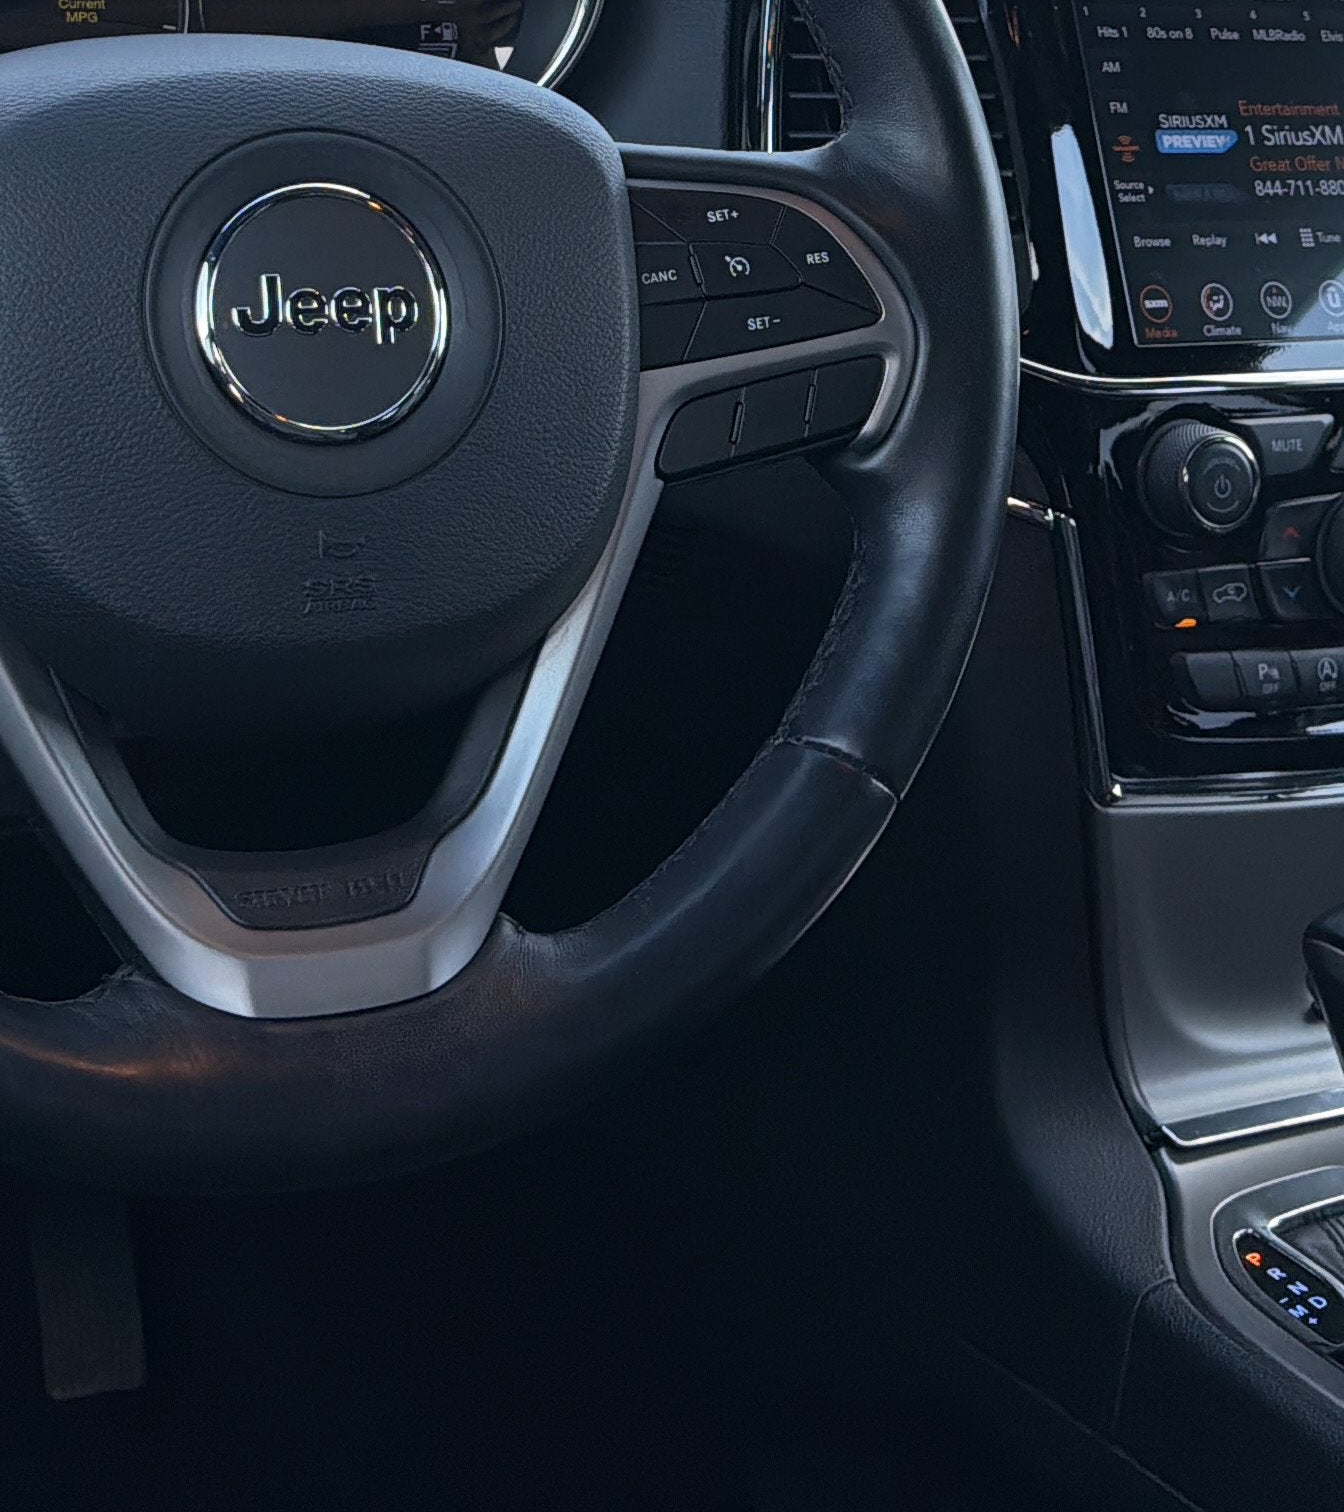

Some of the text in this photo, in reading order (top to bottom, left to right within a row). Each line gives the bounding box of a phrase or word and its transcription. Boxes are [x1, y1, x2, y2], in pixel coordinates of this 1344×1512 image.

[66, 10, 98, 23] MPG
[420, 25, 431, 40] F
[1097, 26, 1120, 38] Hits
[1146, 27, 1194, 39] 80s on 8
[1210, 28, 1240, 40] Pulse
[1321, 30, 1344, 42] Elvis
[1102, 62, 1121, 73] AM
[1109, 102, 1128, 114] FM
[1238, 100, 1341, 116] Entertainment
[1244, 126, 1256, 145] 1
[1261, 125, 1344, 146] SiriusXM
[1163, 135, 1231, 150] PREVIEW
[1250, 156, 1290, 172] Great
[1295, 156, 1330, 172] Offer
[1114, 181, 1145, 191] Source
[1118, 193, 1146, 203] Select
[1134, 236, 1171, 248] Browse
[1192, 235, 1227, 248] Replay
[1316, 233, 1341, 243] Tune
[806, 252, 830, 265] RES
[641, 268, 678, 284] CANC
[231, 273, 419, 345] Jeep
[1204, 325, 1242, 336] Climate
[1272, 437, 1304, 453] MUTE
[1167, 589, 1191, 604] A/C
[1266, 1267, 1286, 1280] R
[1287, 1281, 1308, 1295] N
[1308, 1296, 1327, 1309] D
